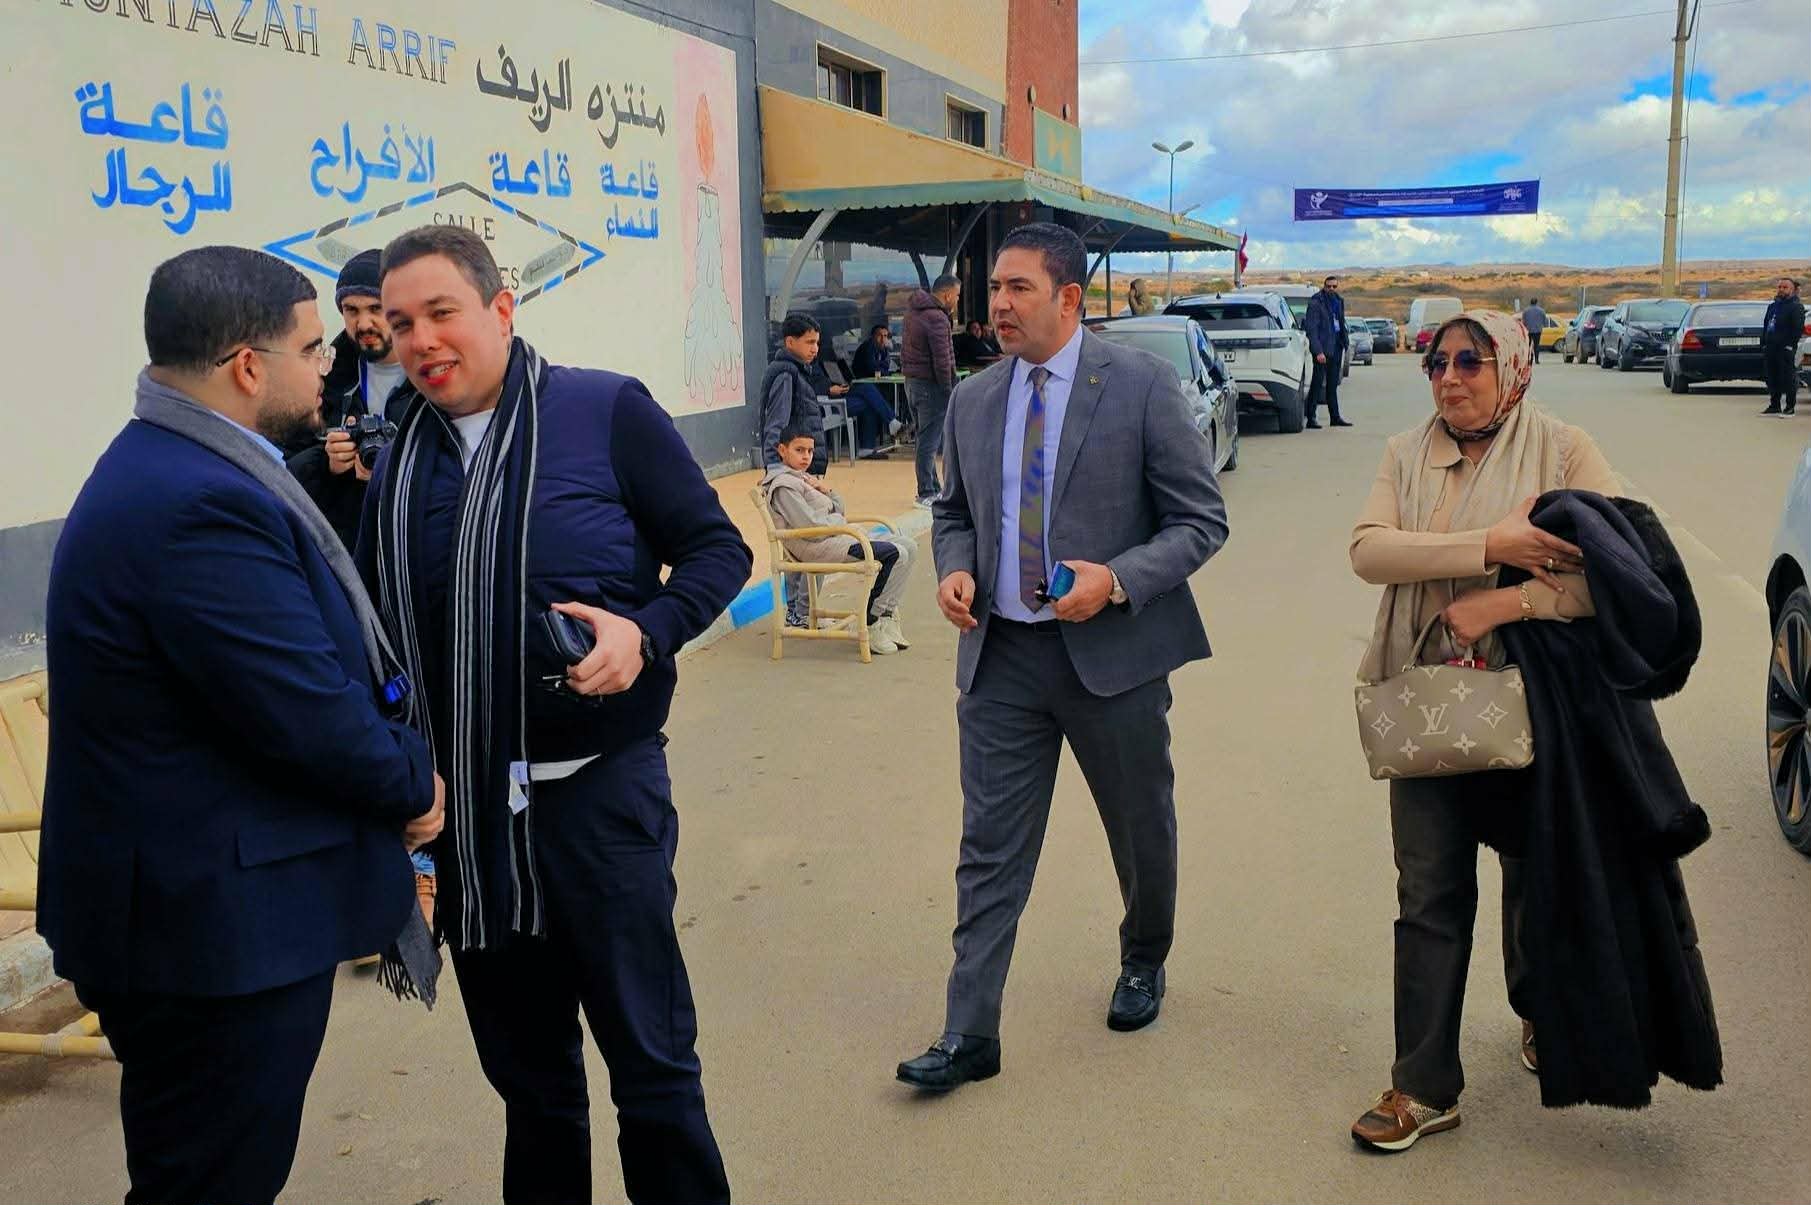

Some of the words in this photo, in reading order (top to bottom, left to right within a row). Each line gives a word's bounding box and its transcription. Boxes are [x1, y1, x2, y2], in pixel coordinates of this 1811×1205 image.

[38, 0, 320, 57] TAZAH
[348, 18, 456, 84] ARRIF
[74, 82, 229, 149] قاعة
[476, 43, 571, 133] الريف
[588, 83, 665, 149] منتزه
[91, 147, 231, 234] للرجال
[310, 120, 435, 202] الأفراح
[489, 148, 571, 197] قاعة
[600, 160, 658, 200] قاعة
[1418, 703, 1449, 735] LV
